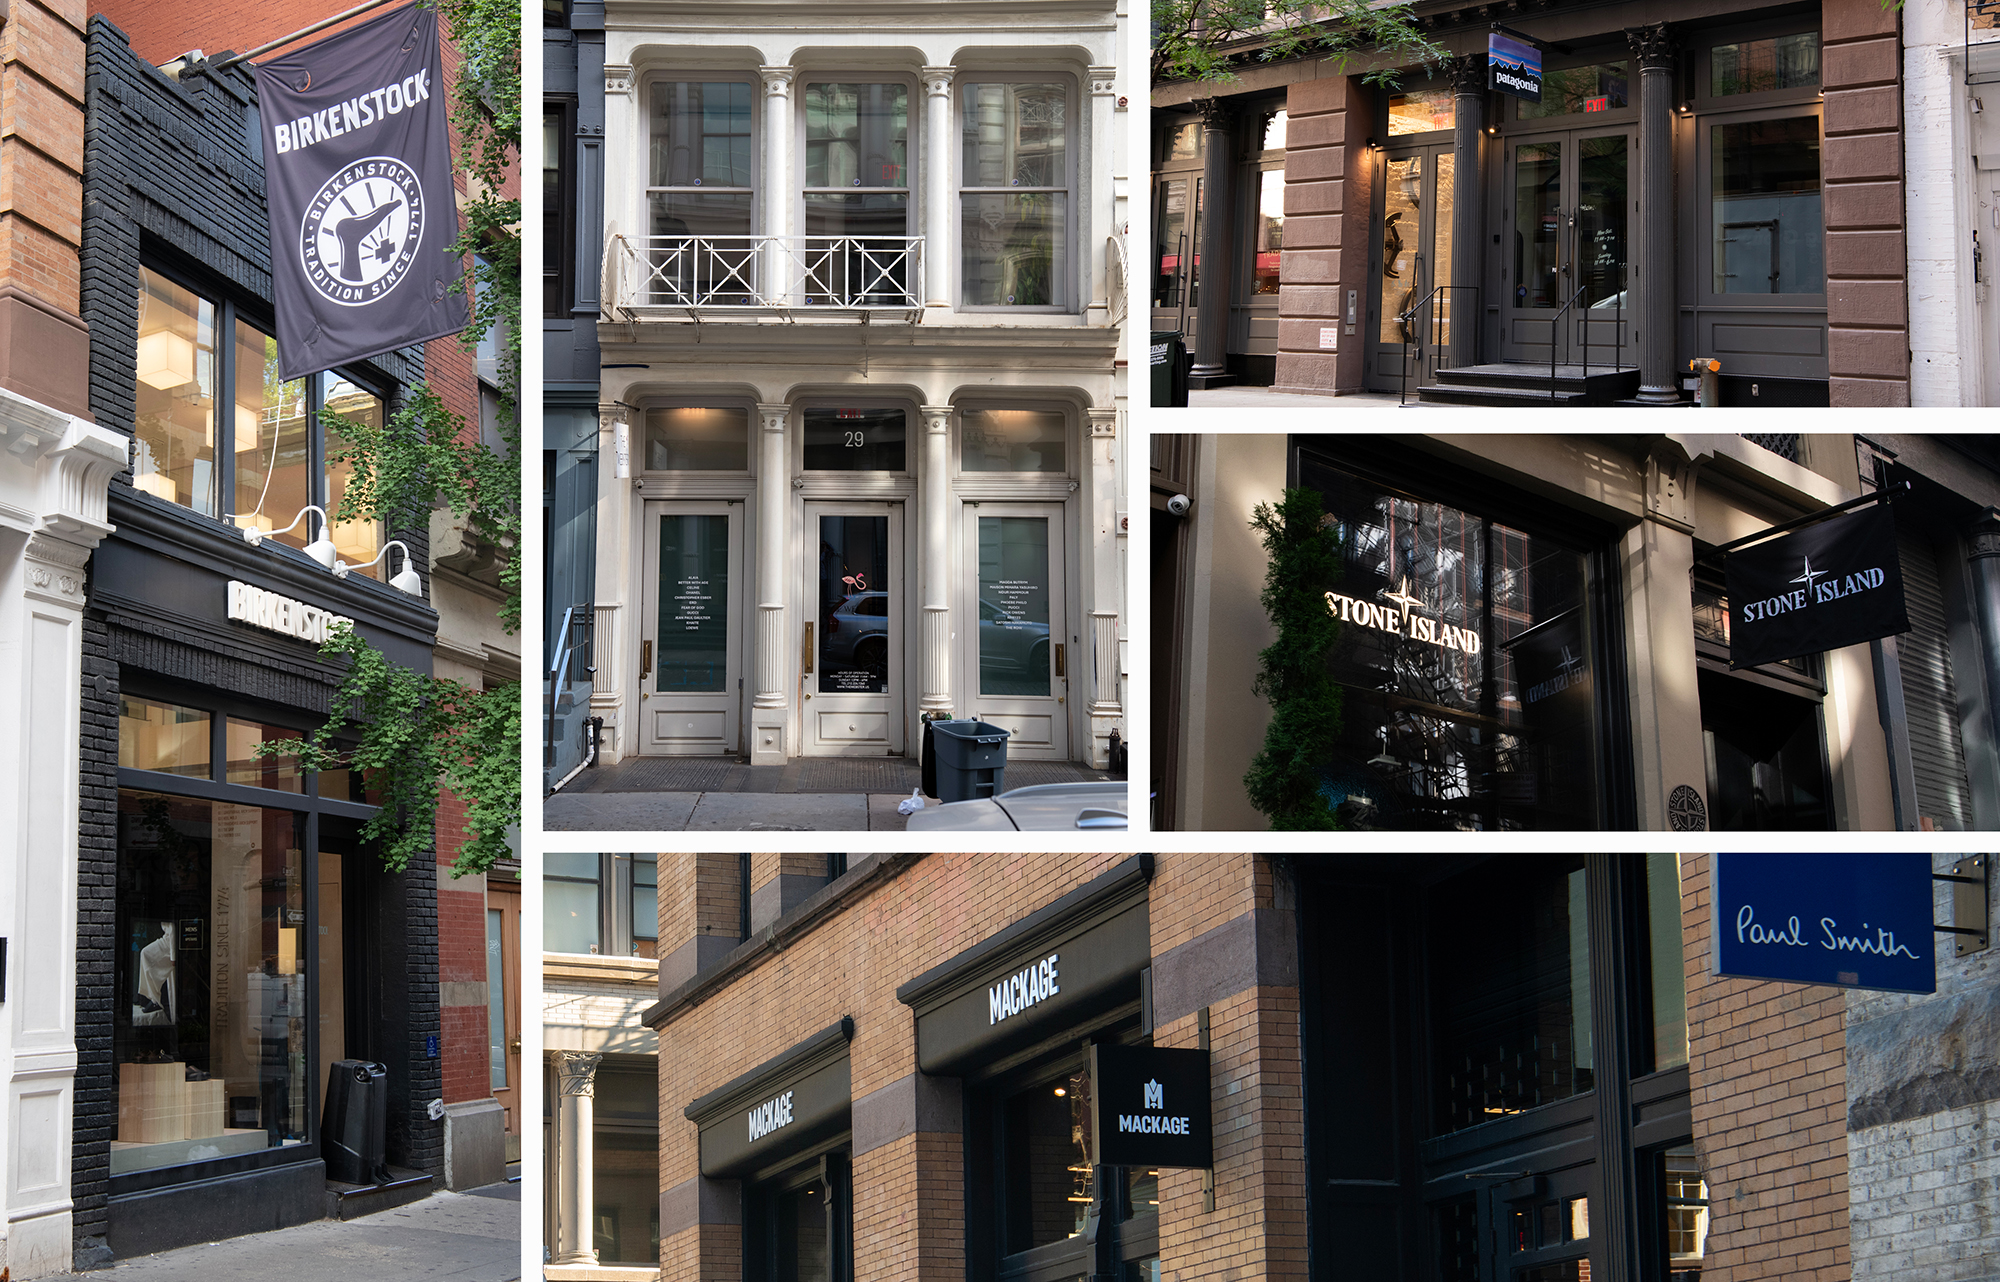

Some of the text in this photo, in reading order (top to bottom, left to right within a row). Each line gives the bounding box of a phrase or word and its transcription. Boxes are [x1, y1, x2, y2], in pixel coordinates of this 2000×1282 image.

[274, 68, 430, 154] BIRKENSTOCK
[1496, 72, 1539, 94] patagonia
[1586, 98, 1606, 113] EXIT
[310, 163, 412, 221] BIRKENSTOCK
[882, 164, 902, 180] EXIT
[305, 235, 412, 300] TRADITION SINCE
[844, 431, 864, 448] 29
[1324, 591, 1481, 654] STONE ISLAND
[1743, 567, 1885, 623] STONE ISLAND
[217, 921, 229, 958] SINCE
[1736, 904, 1921, 960] Paul Smith
[216, 963, 228, 1030] TRADITION
[989, 953, 1060, 1026] MACKAGE
[748, 1090, 795, 1143] MACKAGE
[1118, 1114, 1190, 1135] MACKAGE
